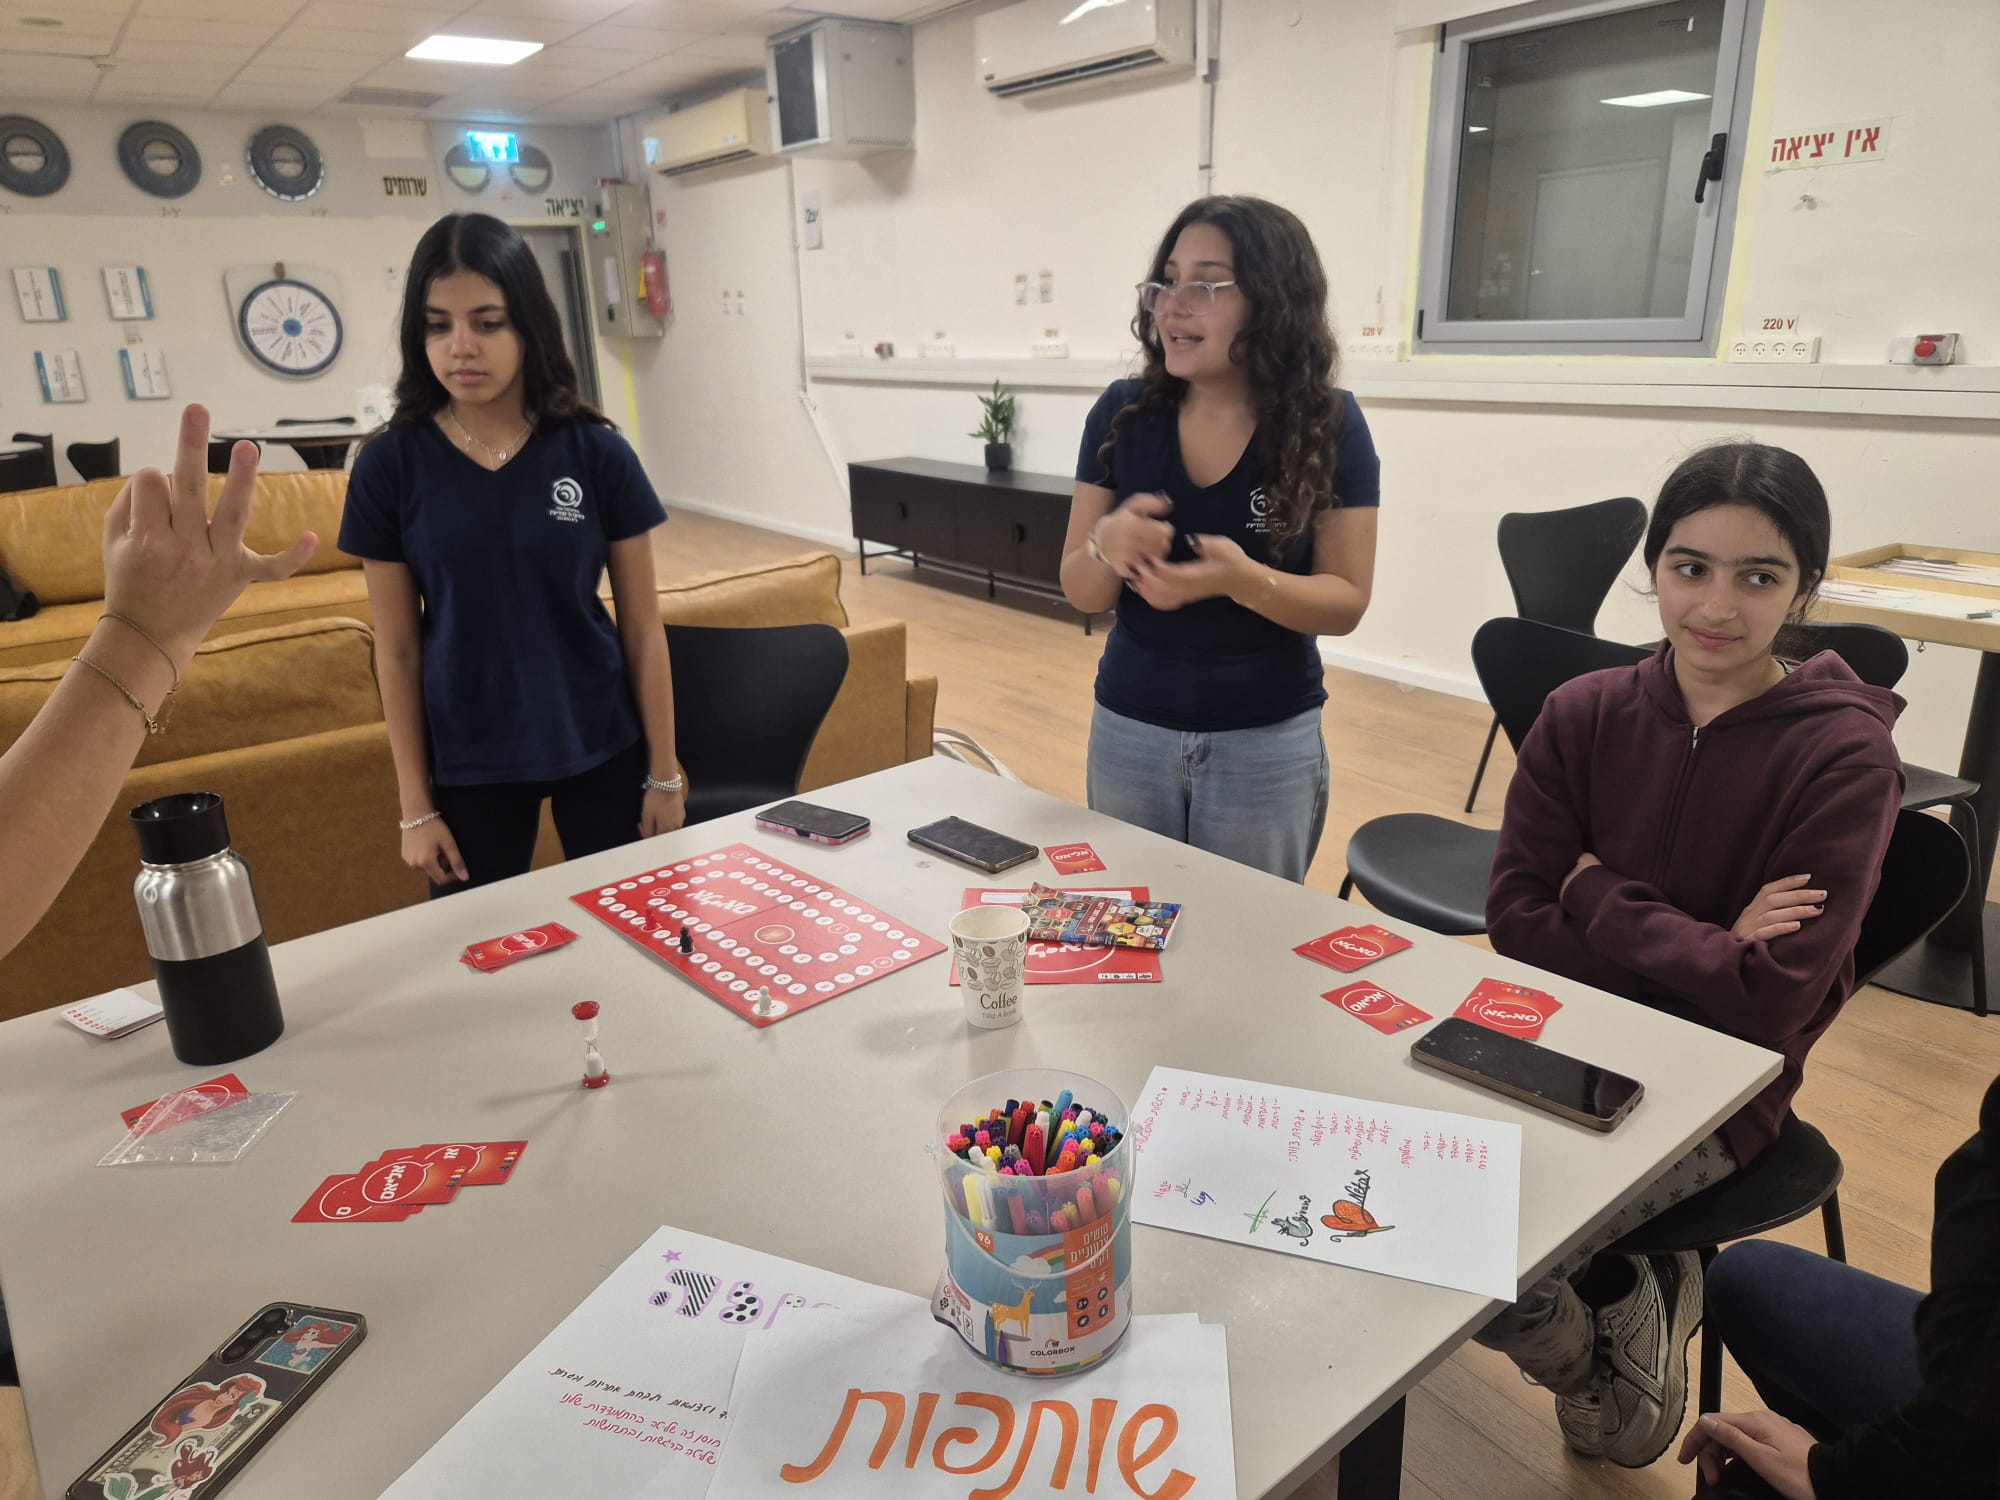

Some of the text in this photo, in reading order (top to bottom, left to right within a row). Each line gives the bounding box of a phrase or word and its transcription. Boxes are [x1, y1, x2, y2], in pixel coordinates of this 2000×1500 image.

[1771, 126, 1881, 163] אין יציאה
[545, 197, 584, 218] יציאה
[1762, 318, 1796, 330] 220 V
[980, 992, 1018, 1010] Coffee
[1350, 991, 1386, 1011] אליאס
[380, 1165, 406, 1200] אליאס
[977, 1232, 991, 1245] 96
[1030, 1346, 1076, 1357] COLORBOX
[560, 1393, 583, 1406] שלנו
[680, 1429, 695, 1439] זה
[780, 1388, 1197, 1500] שותפות
